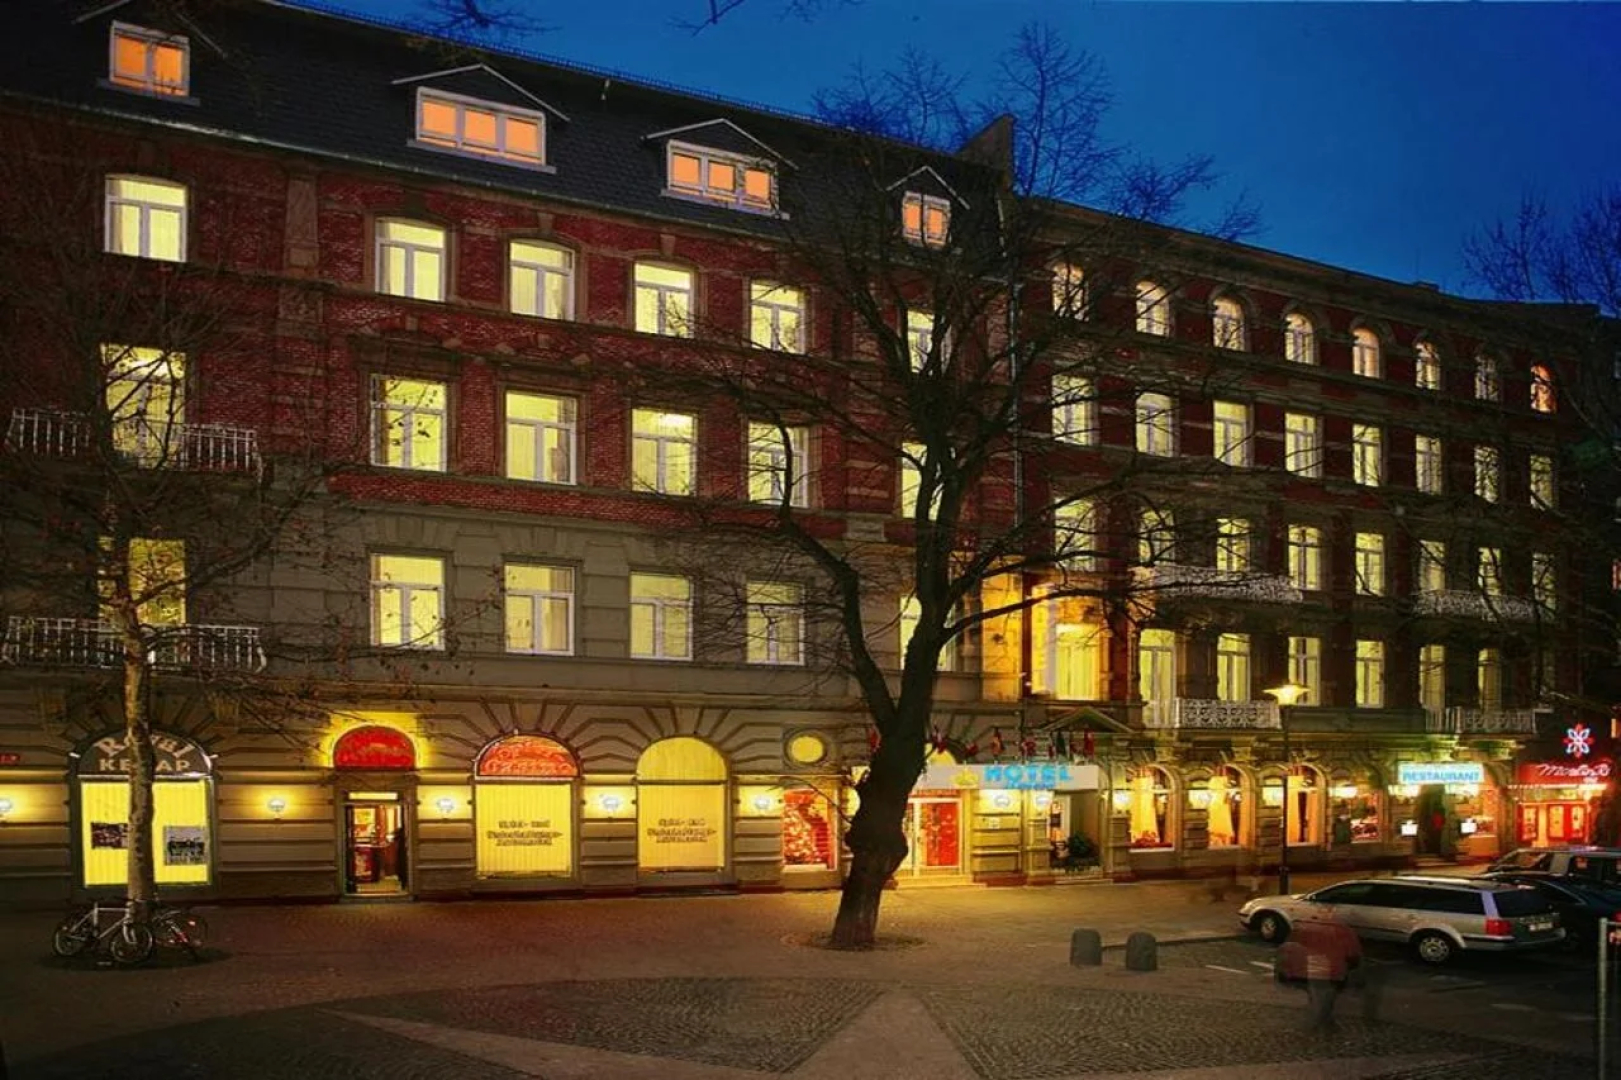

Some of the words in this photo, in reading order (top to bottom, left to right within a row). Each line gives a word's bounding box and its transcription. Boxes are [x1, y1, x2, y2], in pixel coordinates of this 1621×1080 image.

[99, 759, 190, 771] KEAP
[984, 764, 1073, 782] HOTEL
[1402, 770, 1480, 782] RESTAURANT
